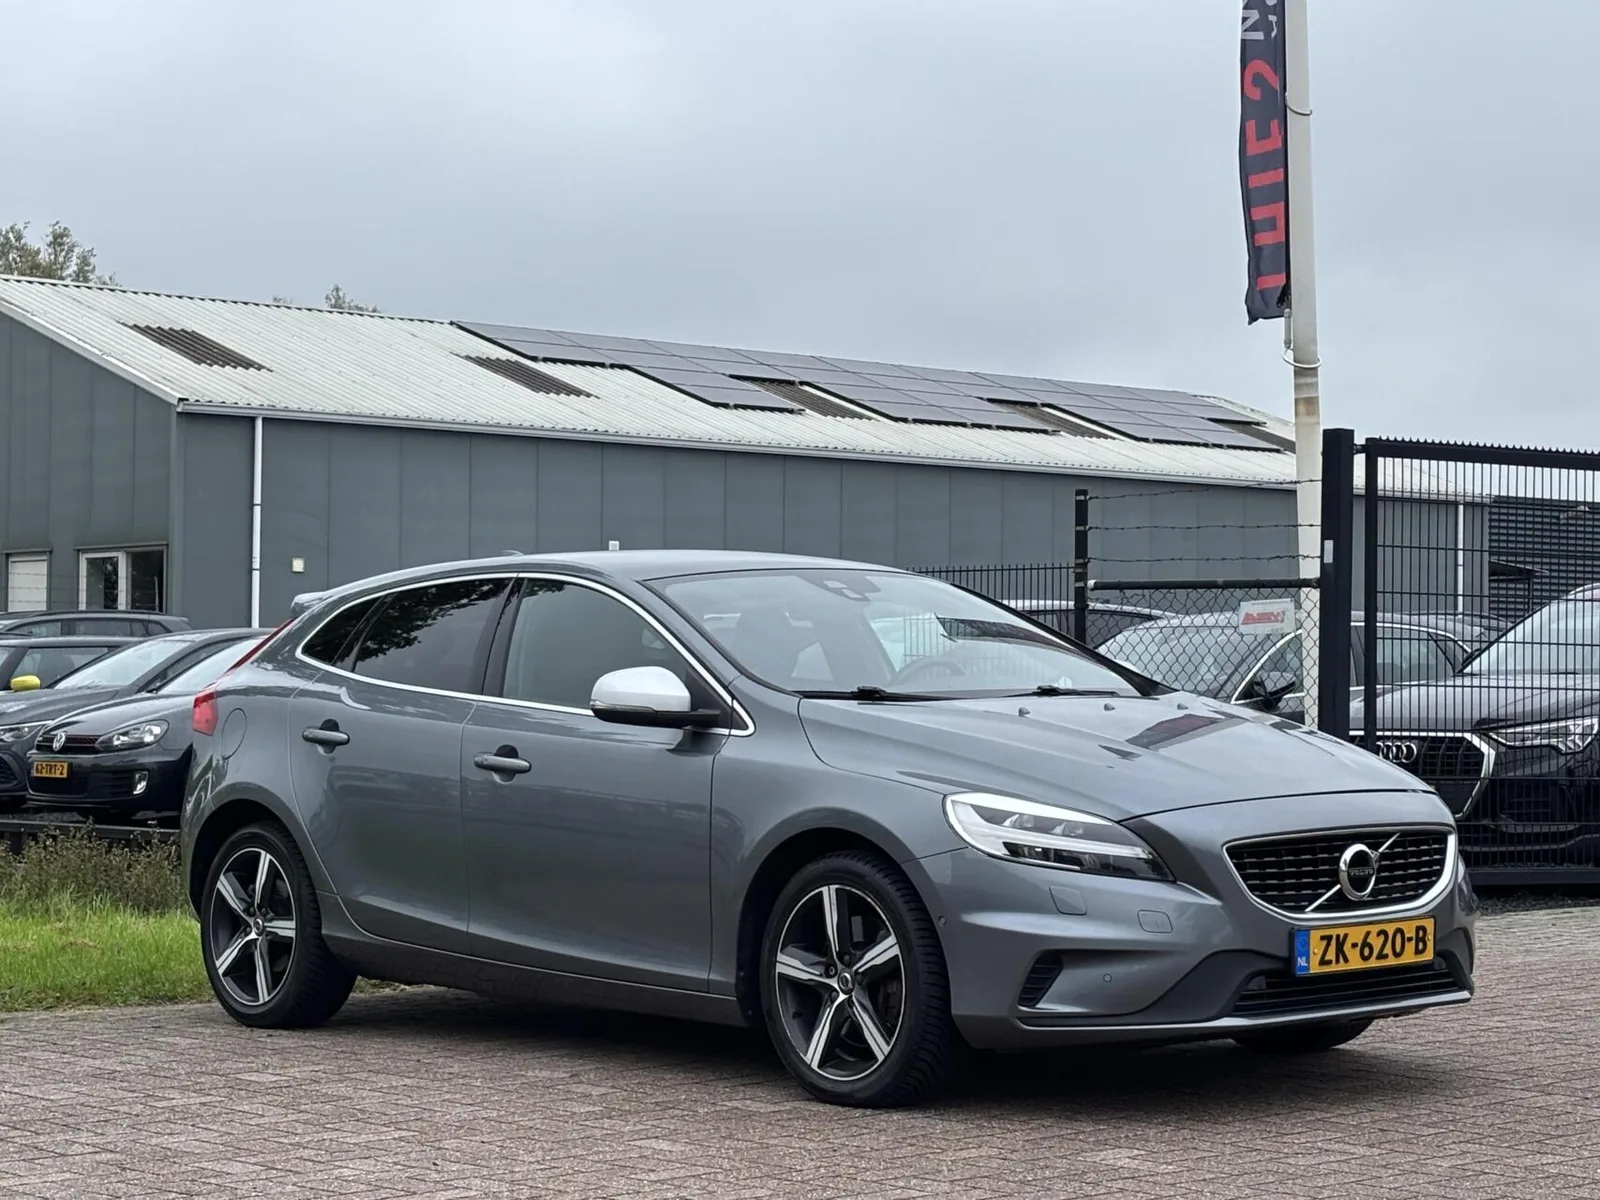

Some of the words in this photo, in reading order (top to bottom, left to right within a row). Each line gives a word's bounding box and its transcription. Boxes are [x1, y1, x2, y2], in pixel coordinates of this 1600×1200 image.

[1349, 868, 1374, 876] VOLVO
[1297, 957, 1308, 966] NL
[1318, 925, 1428, 967] ZK-620-B
